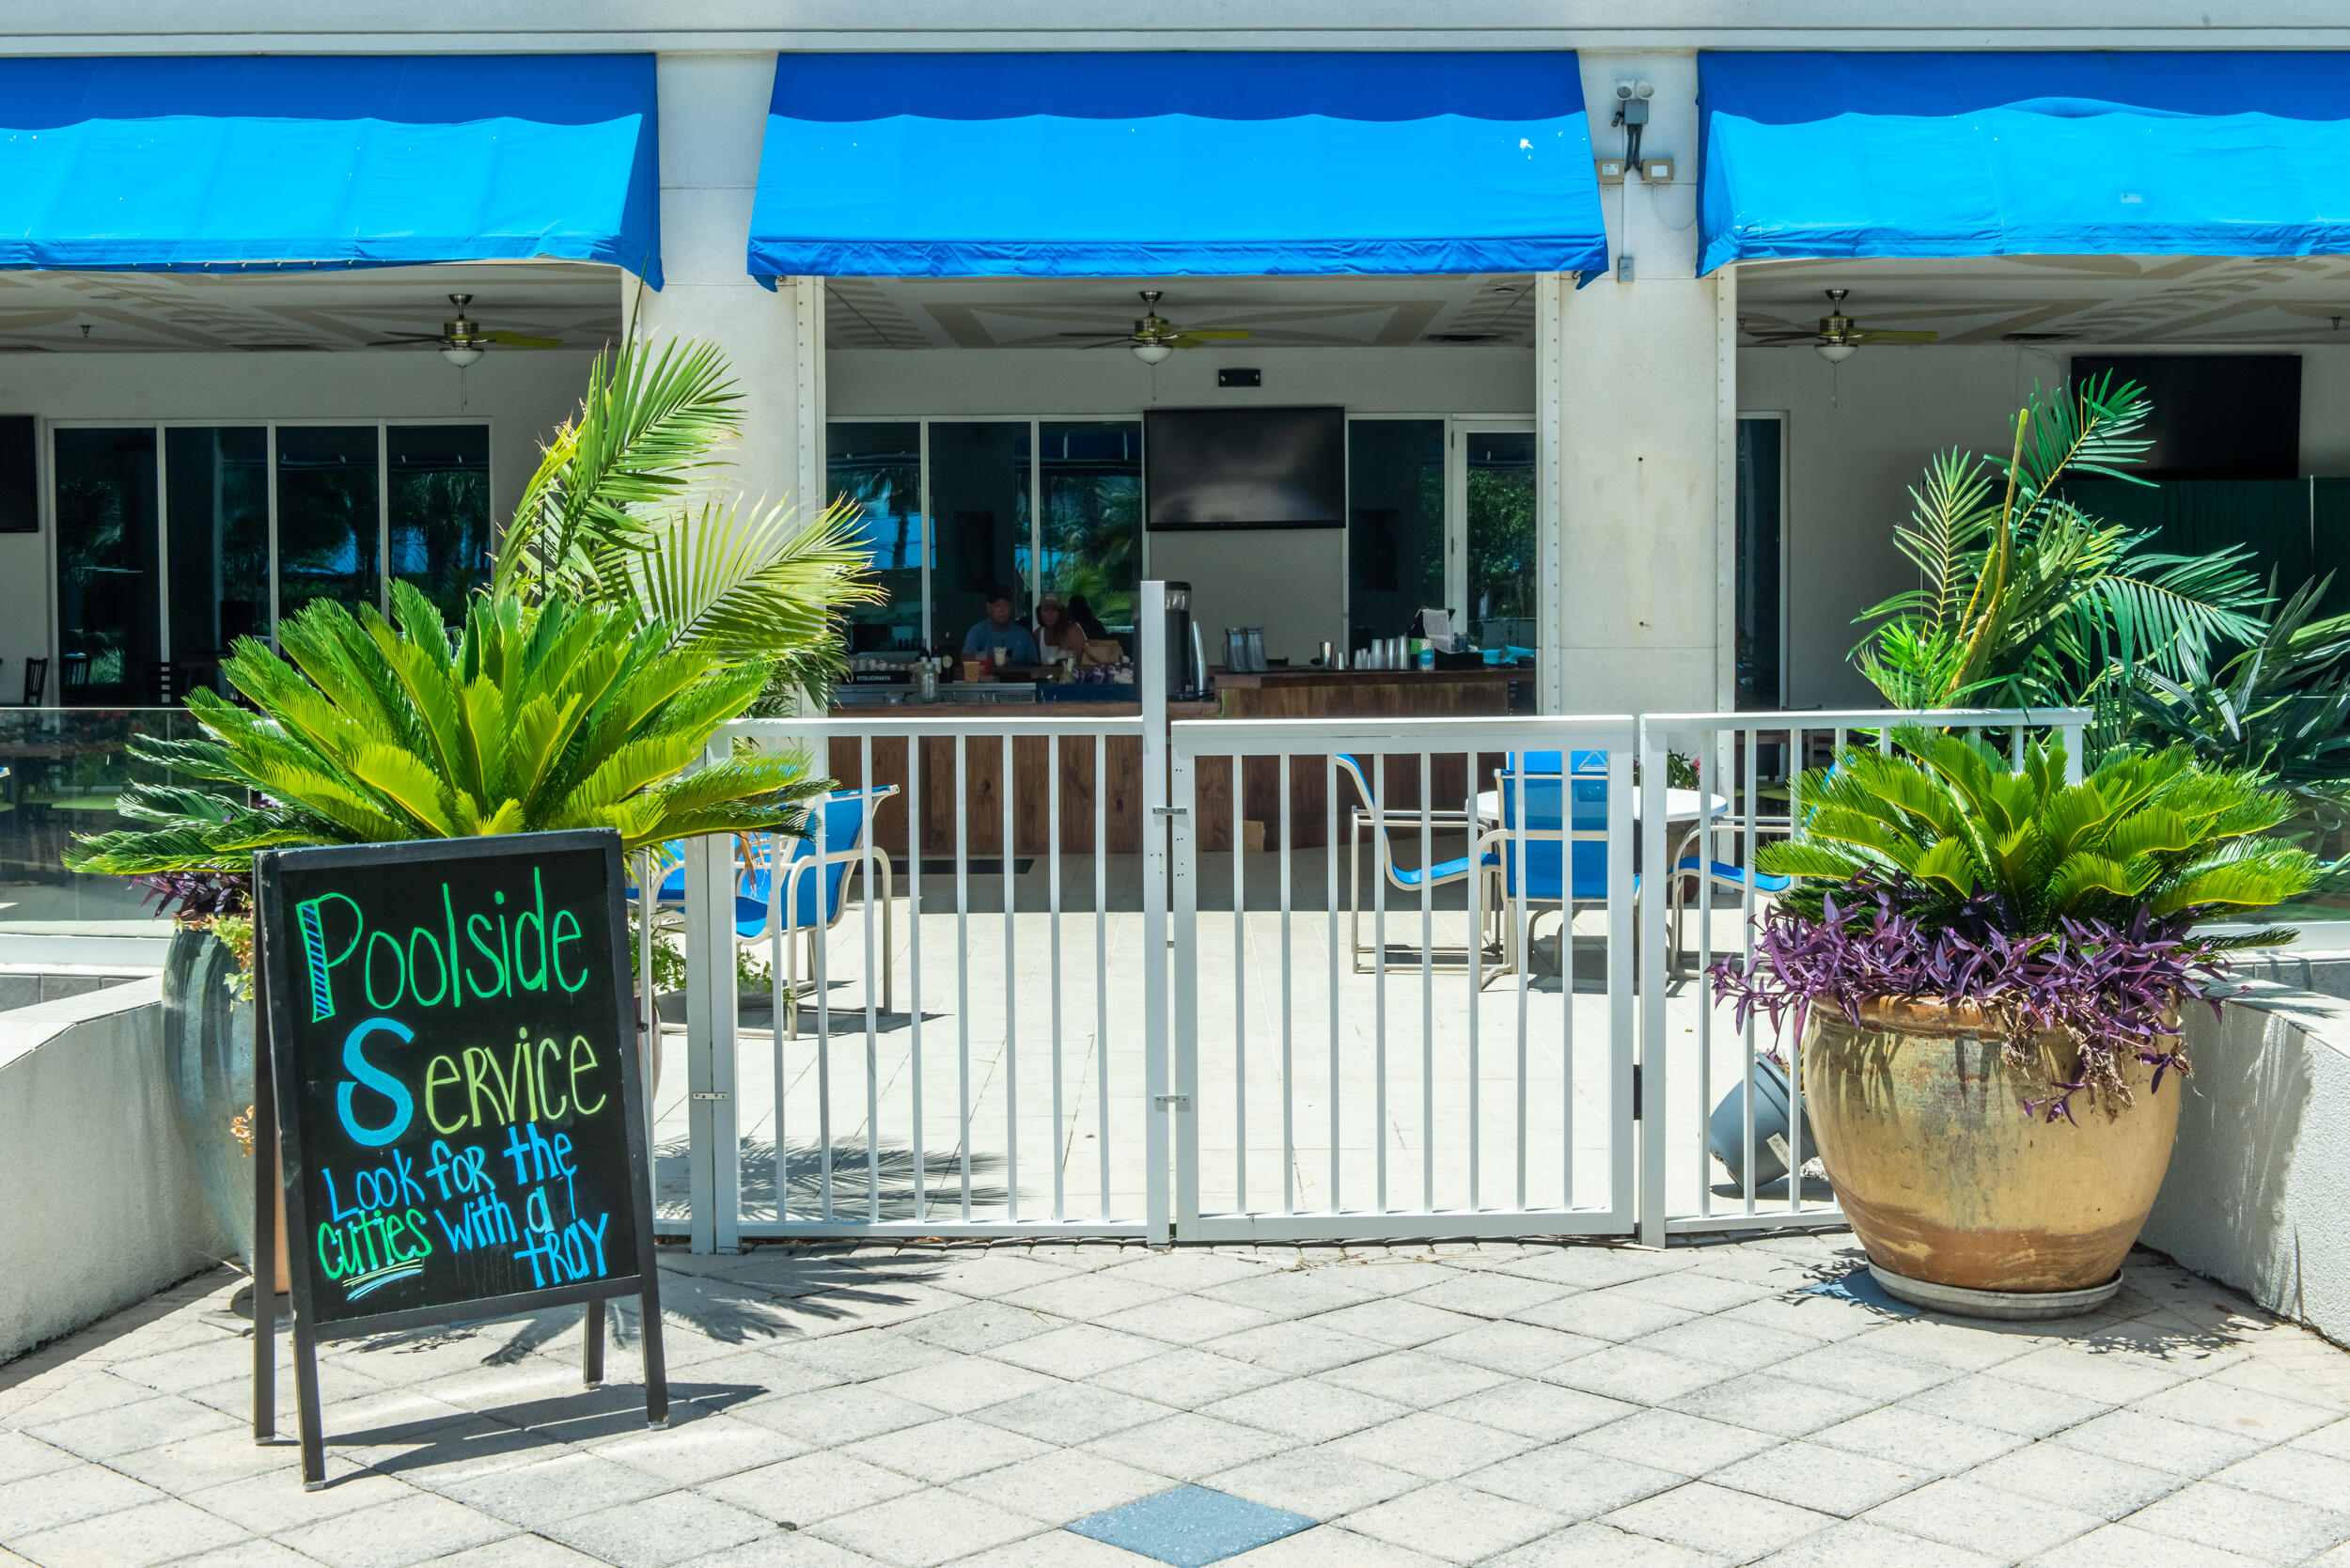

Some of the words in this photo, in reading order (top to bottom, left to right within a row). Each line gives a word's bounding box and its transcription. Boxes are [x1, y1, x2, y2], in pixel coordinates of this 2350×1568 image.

[296, 866, 588, 1023] Poolside
[321, 1148, 426, 1223] Look
[503, 1121, 577, 1185] the
[318, 1209, 432, 1279] cuties
[433, 1190, 518, 1253] with
[526, 1185, 555, 1233] a
